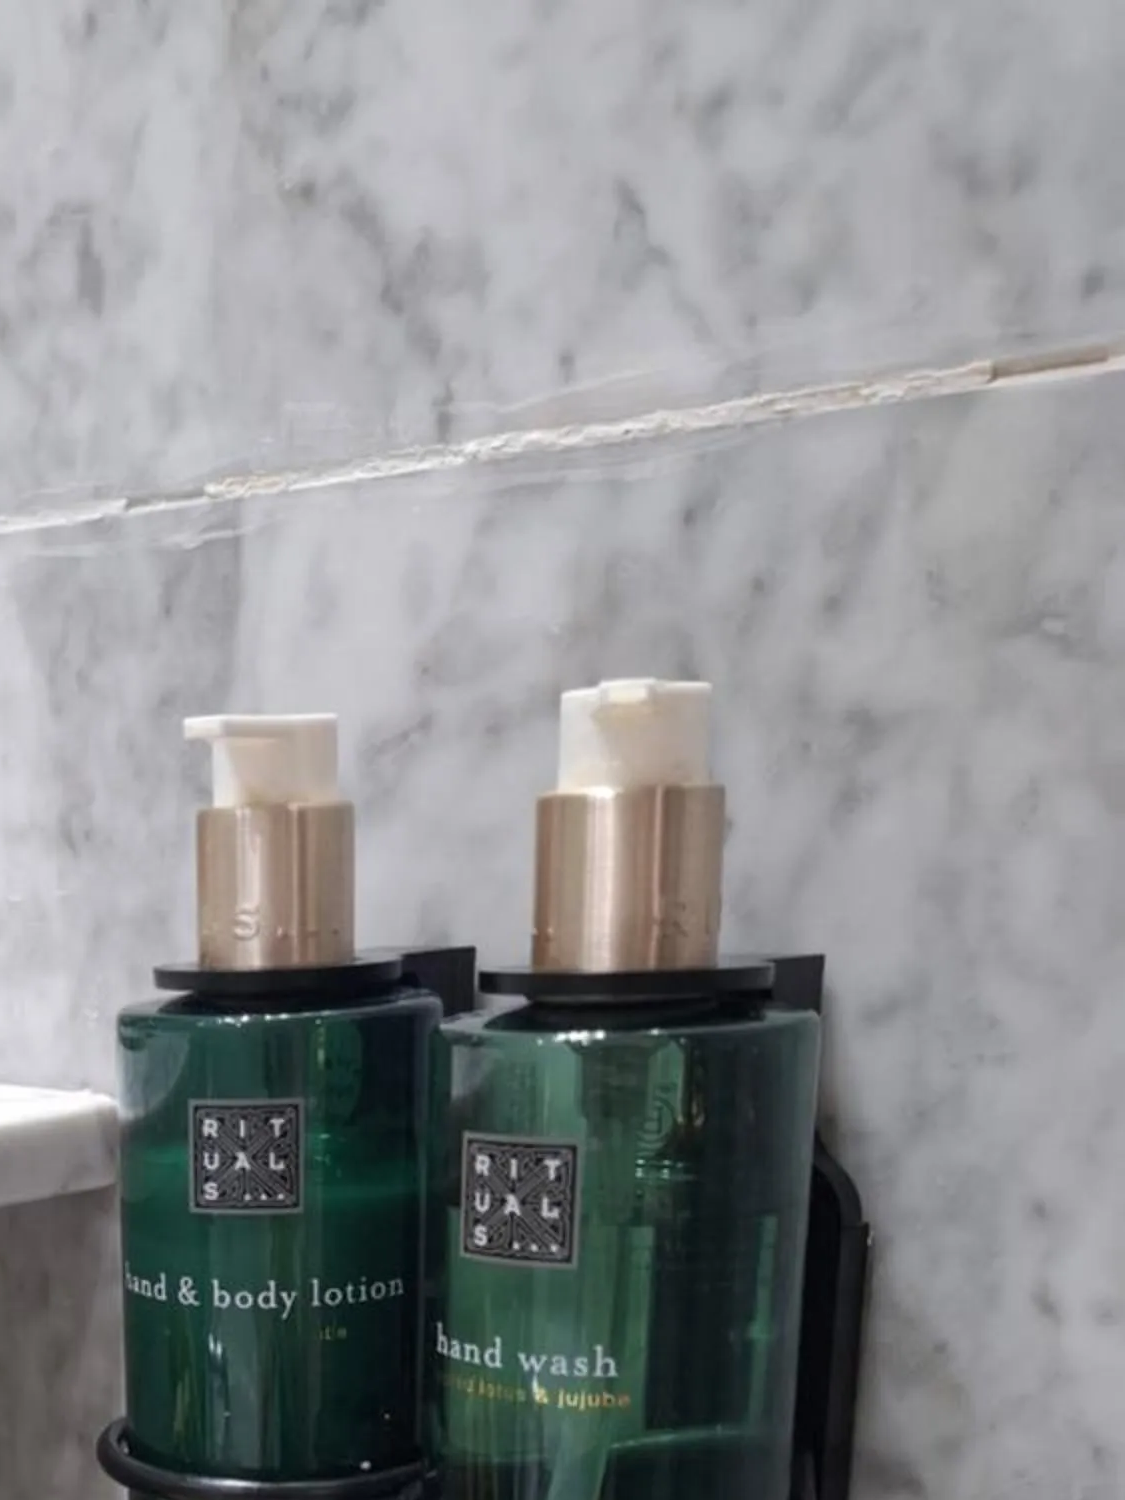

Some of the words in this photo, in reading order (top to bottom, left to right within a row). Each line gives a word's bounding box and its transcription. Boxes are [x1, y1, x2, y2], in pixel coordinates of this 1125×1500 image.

[177, 1275, 201, 1308] &
[212, 1278, 298, 1321] body
[310, 1275, 405, 1308] lotion
[435, 1321, 504, 1370] hand
[516, 1344, 619, 1378] wash
